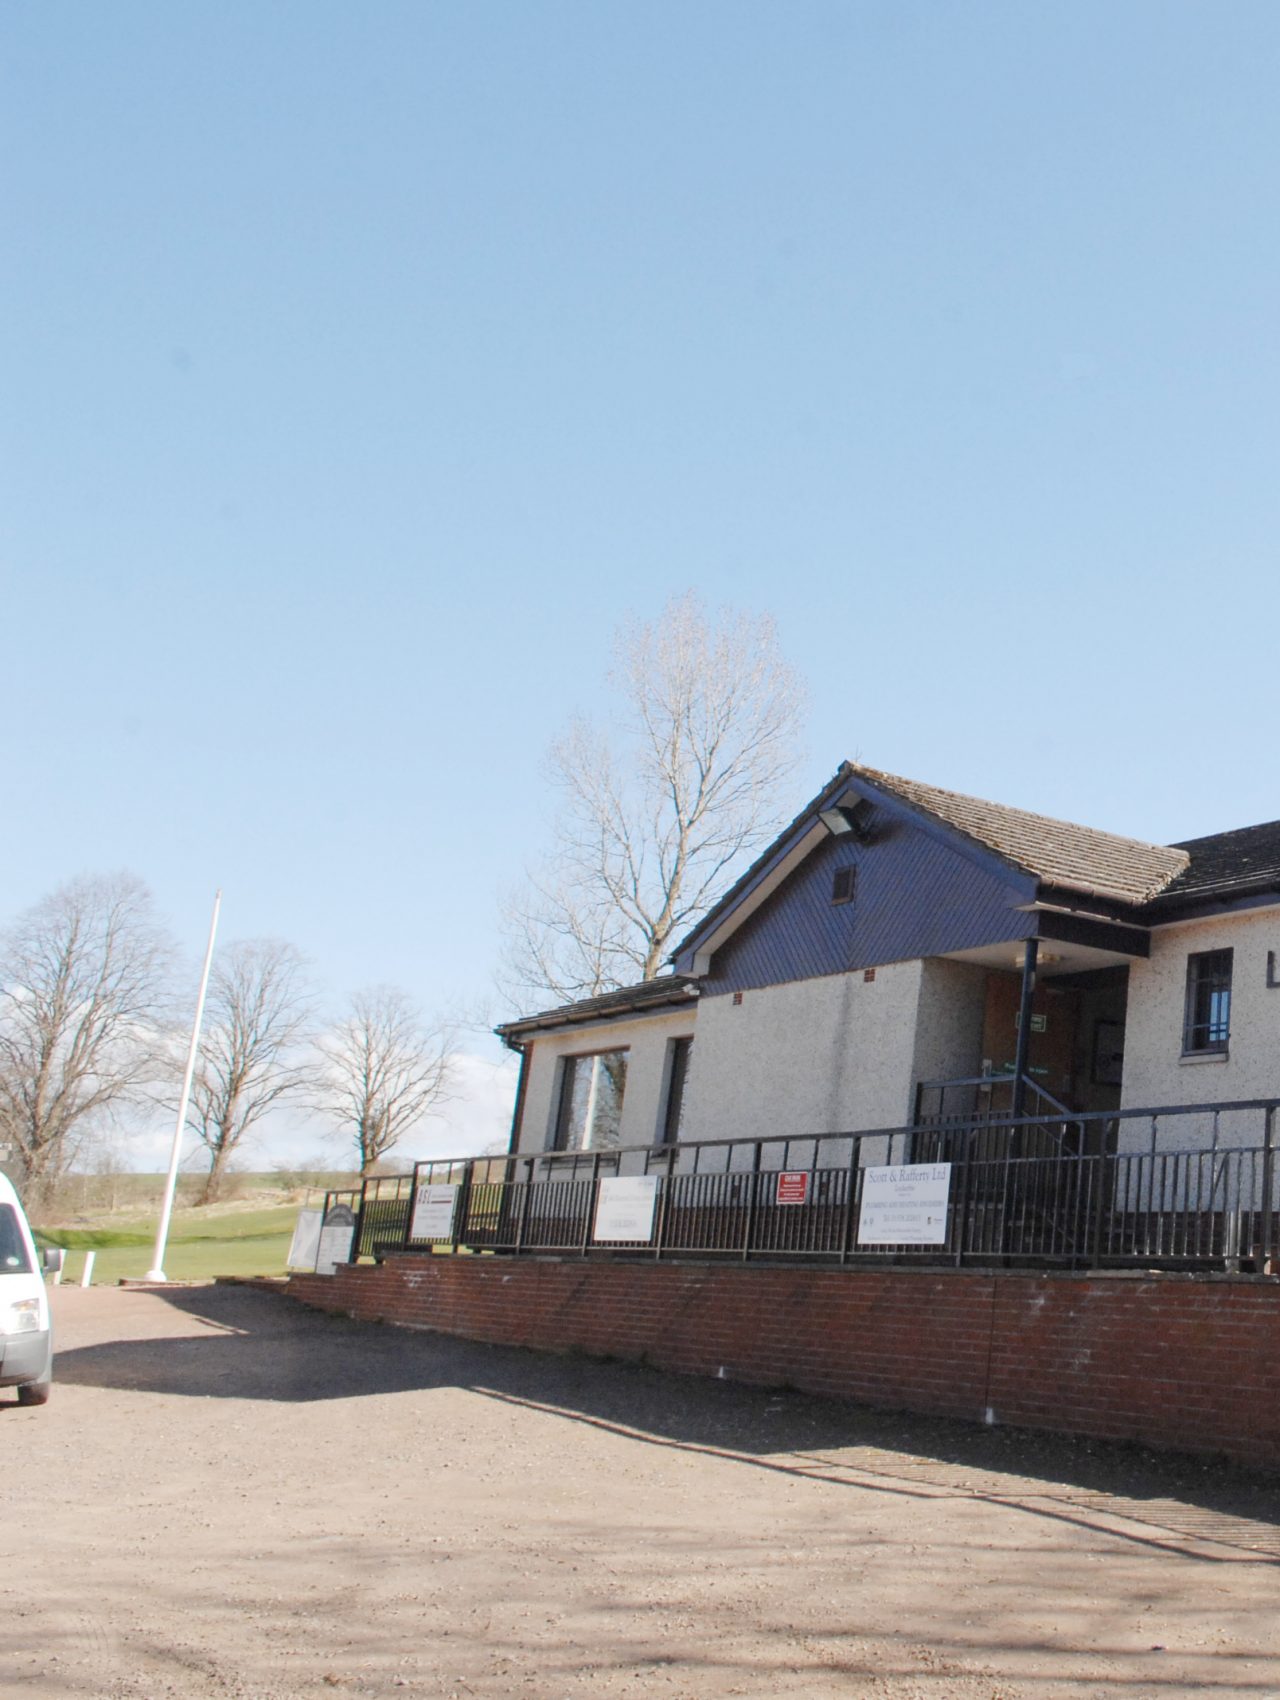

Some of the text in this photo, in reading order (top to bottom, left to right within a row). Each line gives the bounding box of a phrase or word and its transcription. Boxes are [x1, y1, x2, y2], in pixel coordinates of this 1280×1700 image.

[869, 1166, 946, 1184] Scott & Rafferty Ltd
